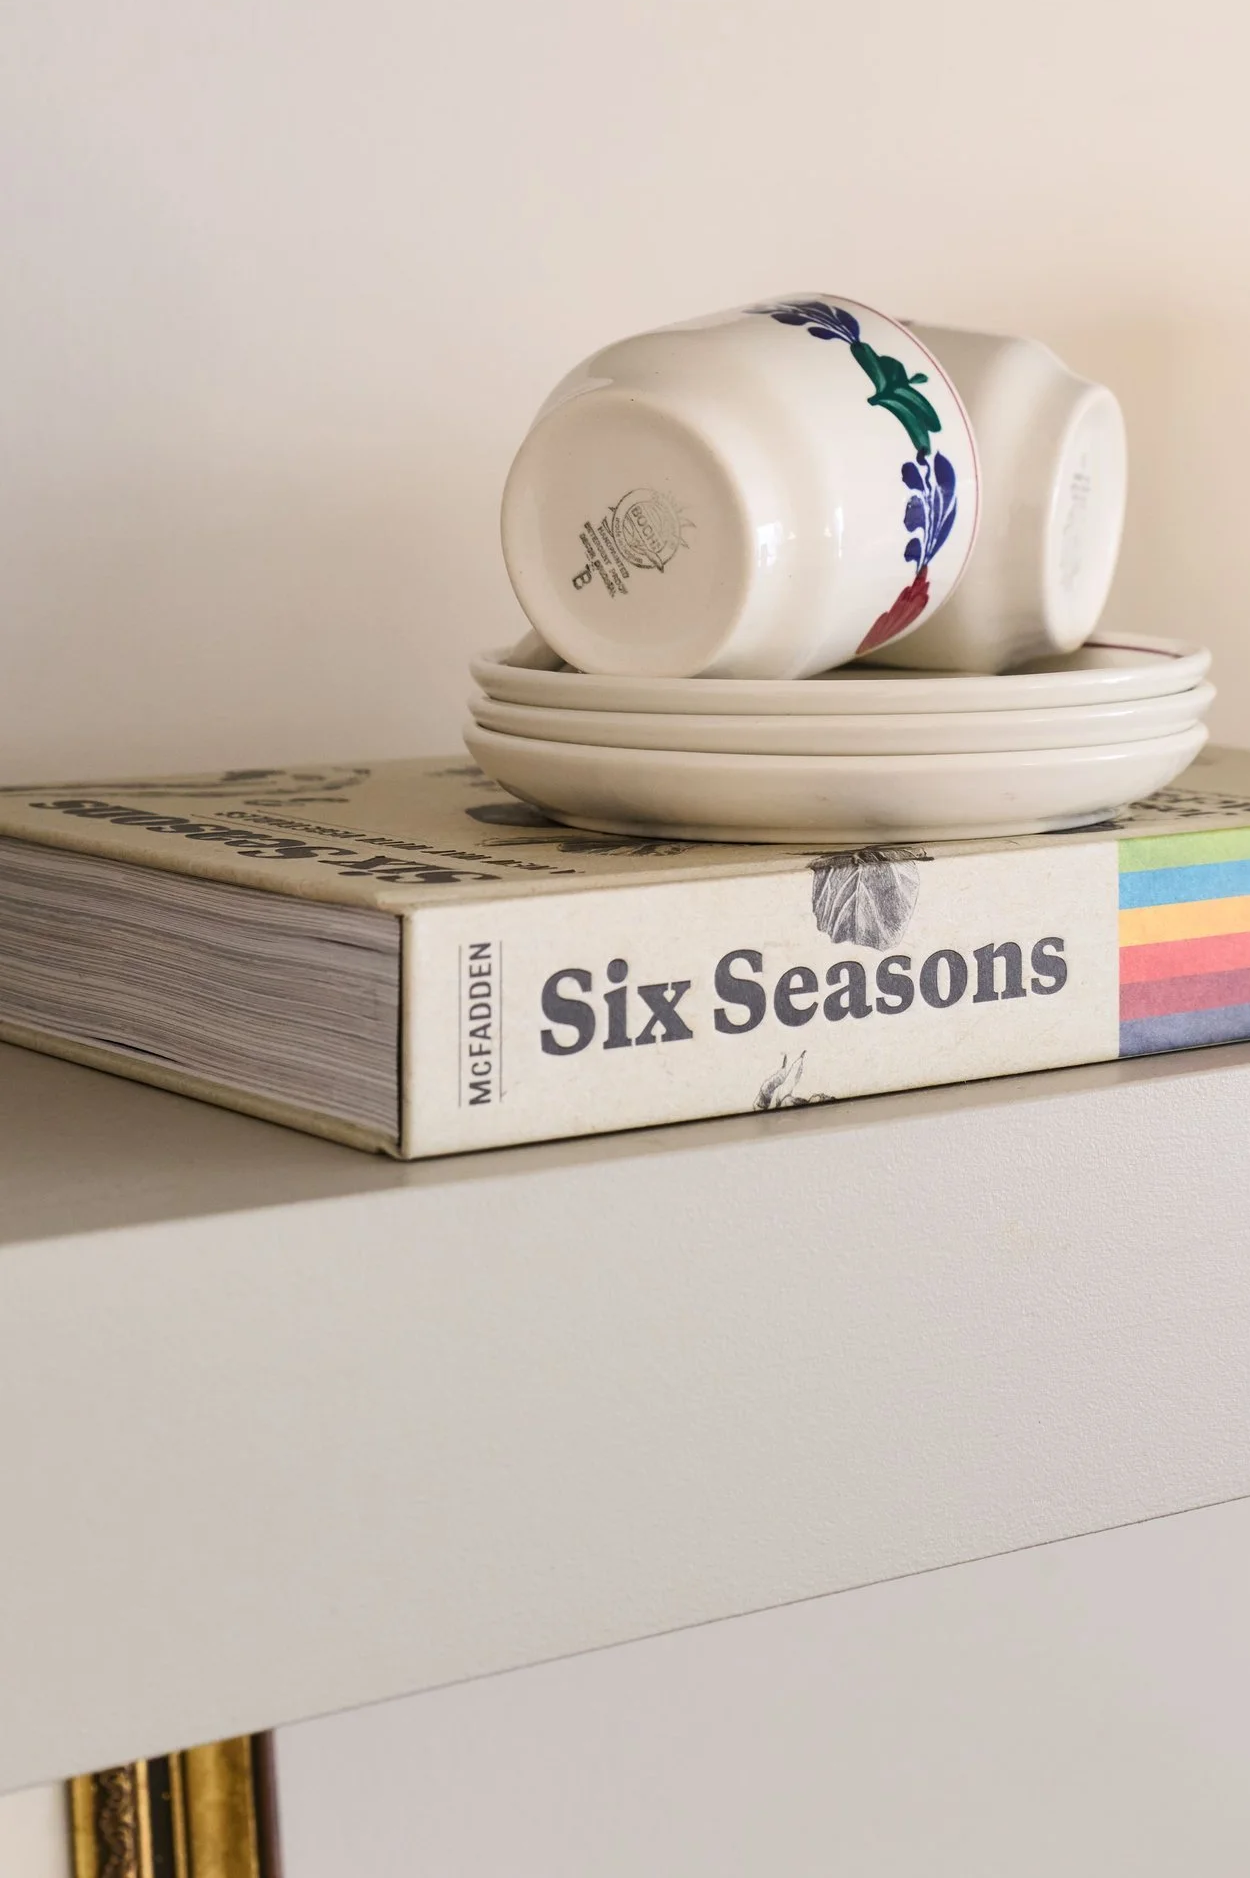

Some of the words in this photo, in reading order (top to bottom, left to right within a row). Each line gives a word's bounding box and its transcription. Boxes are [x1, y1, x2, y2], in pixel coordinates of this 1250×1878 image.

[27, 800, 358, 860] Seasons
[354, 838, 434, 852] WITH
[316, 856, 501, 885] Six
[469, 942, 492, 1105] MCFADDEN
[540, 958, 694, 1056] Six
[713, 936, 1069, 1034] Seasons
